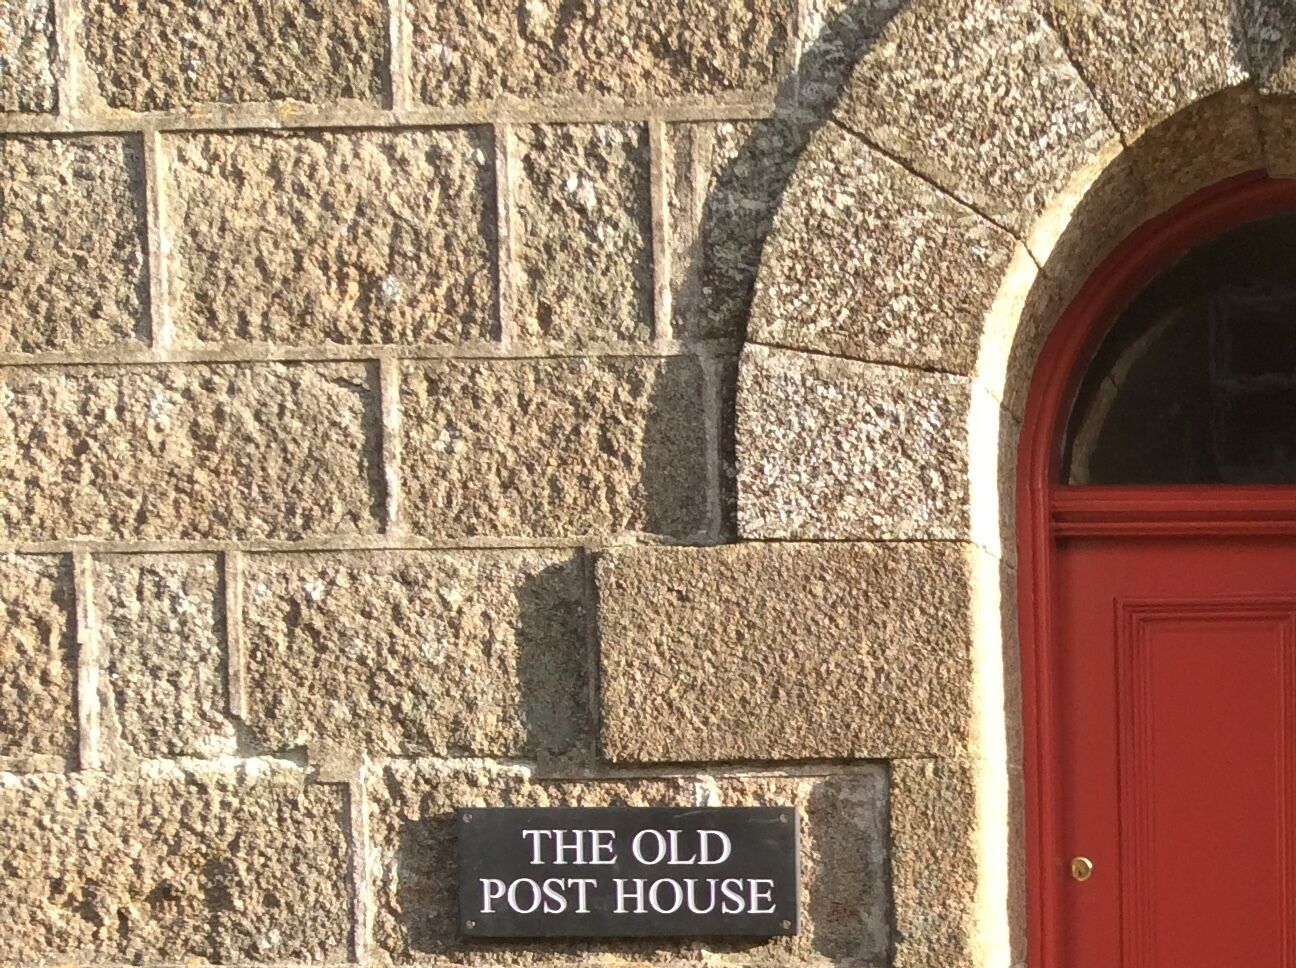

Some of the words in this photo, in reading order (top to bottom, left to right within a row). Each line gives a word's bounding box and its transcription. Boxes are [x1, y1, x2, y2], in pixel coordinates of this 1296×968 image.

[522, 829, 618, 865] THE
[632, 829, 732, 865] OLD
[479, 878, 598, 914] POST
[612, 878, 777, 914] HOUSE
